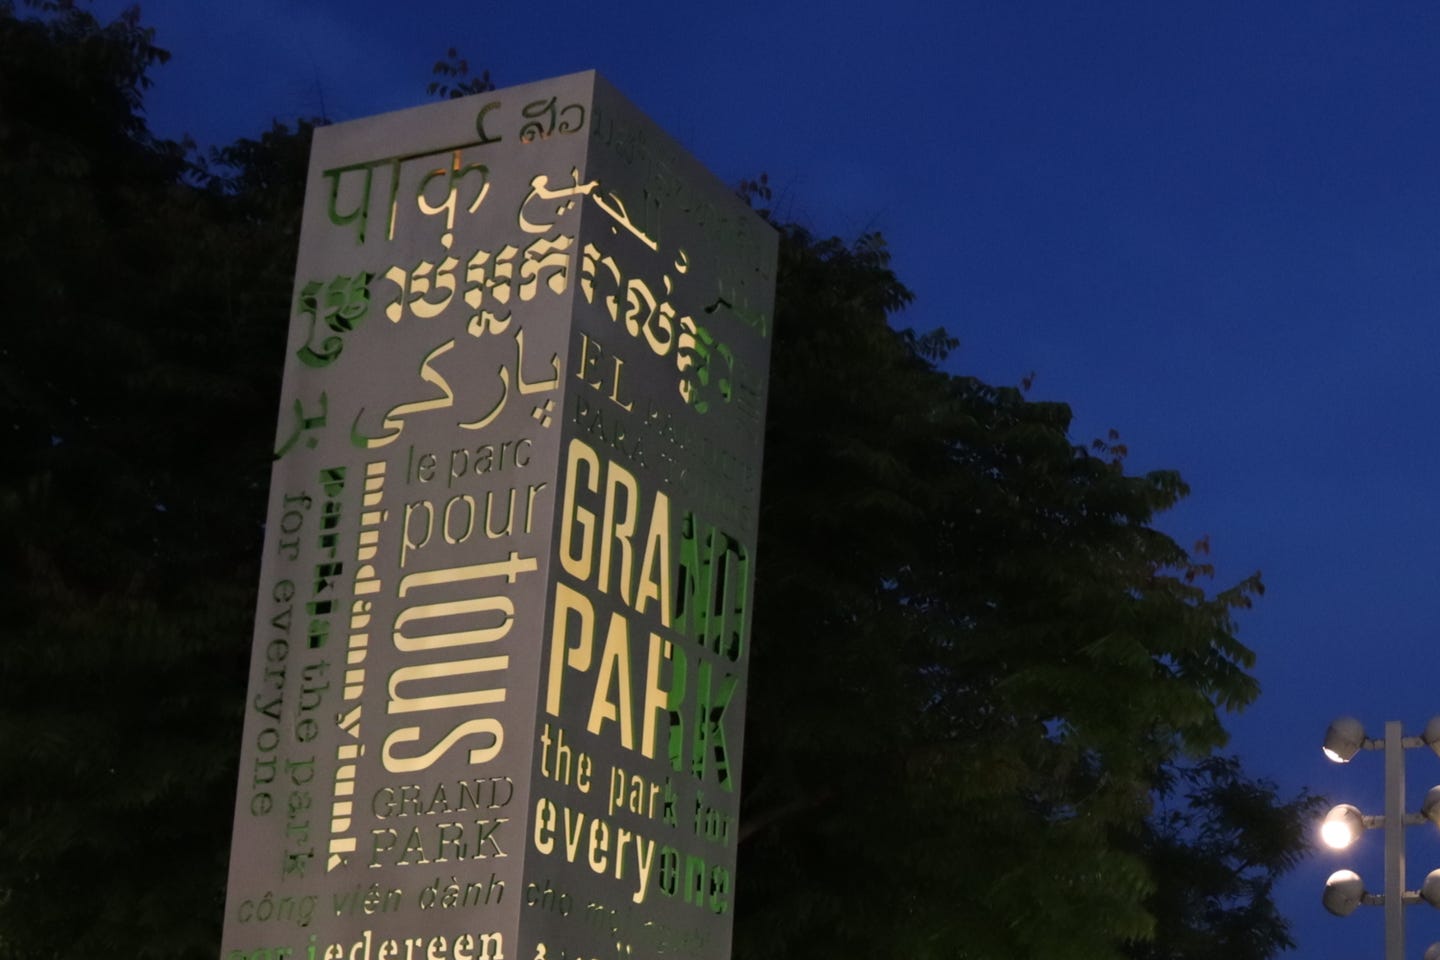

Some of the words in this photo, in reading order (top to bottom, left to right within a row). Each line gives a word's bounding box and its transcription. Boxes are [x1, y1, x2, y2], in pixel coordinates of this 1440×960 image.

[407, 444, 438, 484] le
[448, 436, 534, 489] parc
[278, 493, 312, 562] for
[400, 481, 548, 568] pour
[557, 437, 750, 663] GRAND
[250, 578, 296, 817] everyone
[294, 656, 331, 744] the
[380, 550, 539, 774] tous
[545, 581, 740, 793] PARK
[280, 757, 318, 878] park
[370, 776, 514, 820] GRAND
[539, 722, 593, 794] the
[608, 762, 680, 828] park
[368, 817, 510, 869] PARK
[419, 873, 506, 910] dành
[533, 796, 730, 915] everyone
